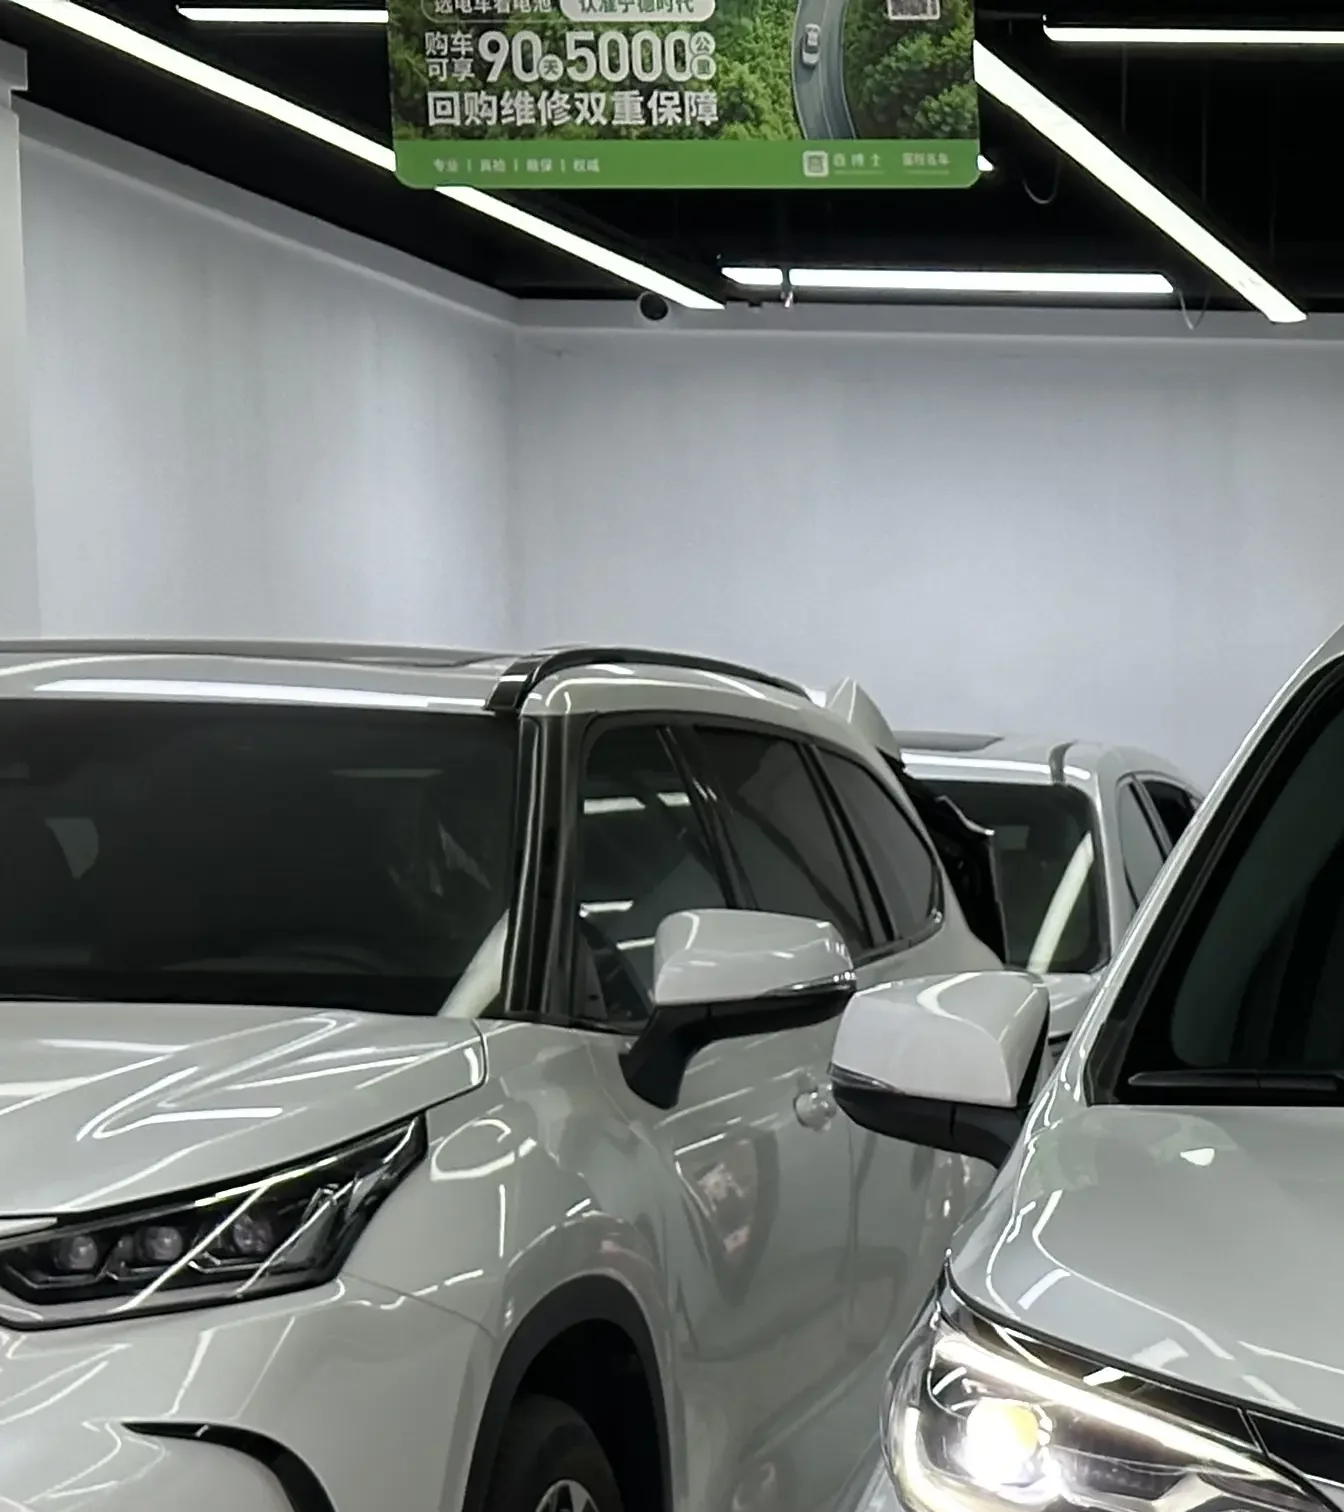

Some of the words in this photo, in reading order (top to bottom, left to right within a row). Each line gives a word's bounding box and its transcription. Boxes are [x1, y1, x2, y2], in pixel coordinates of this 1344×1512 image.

[427, 90, 719, 126] 回购维修双重保障
